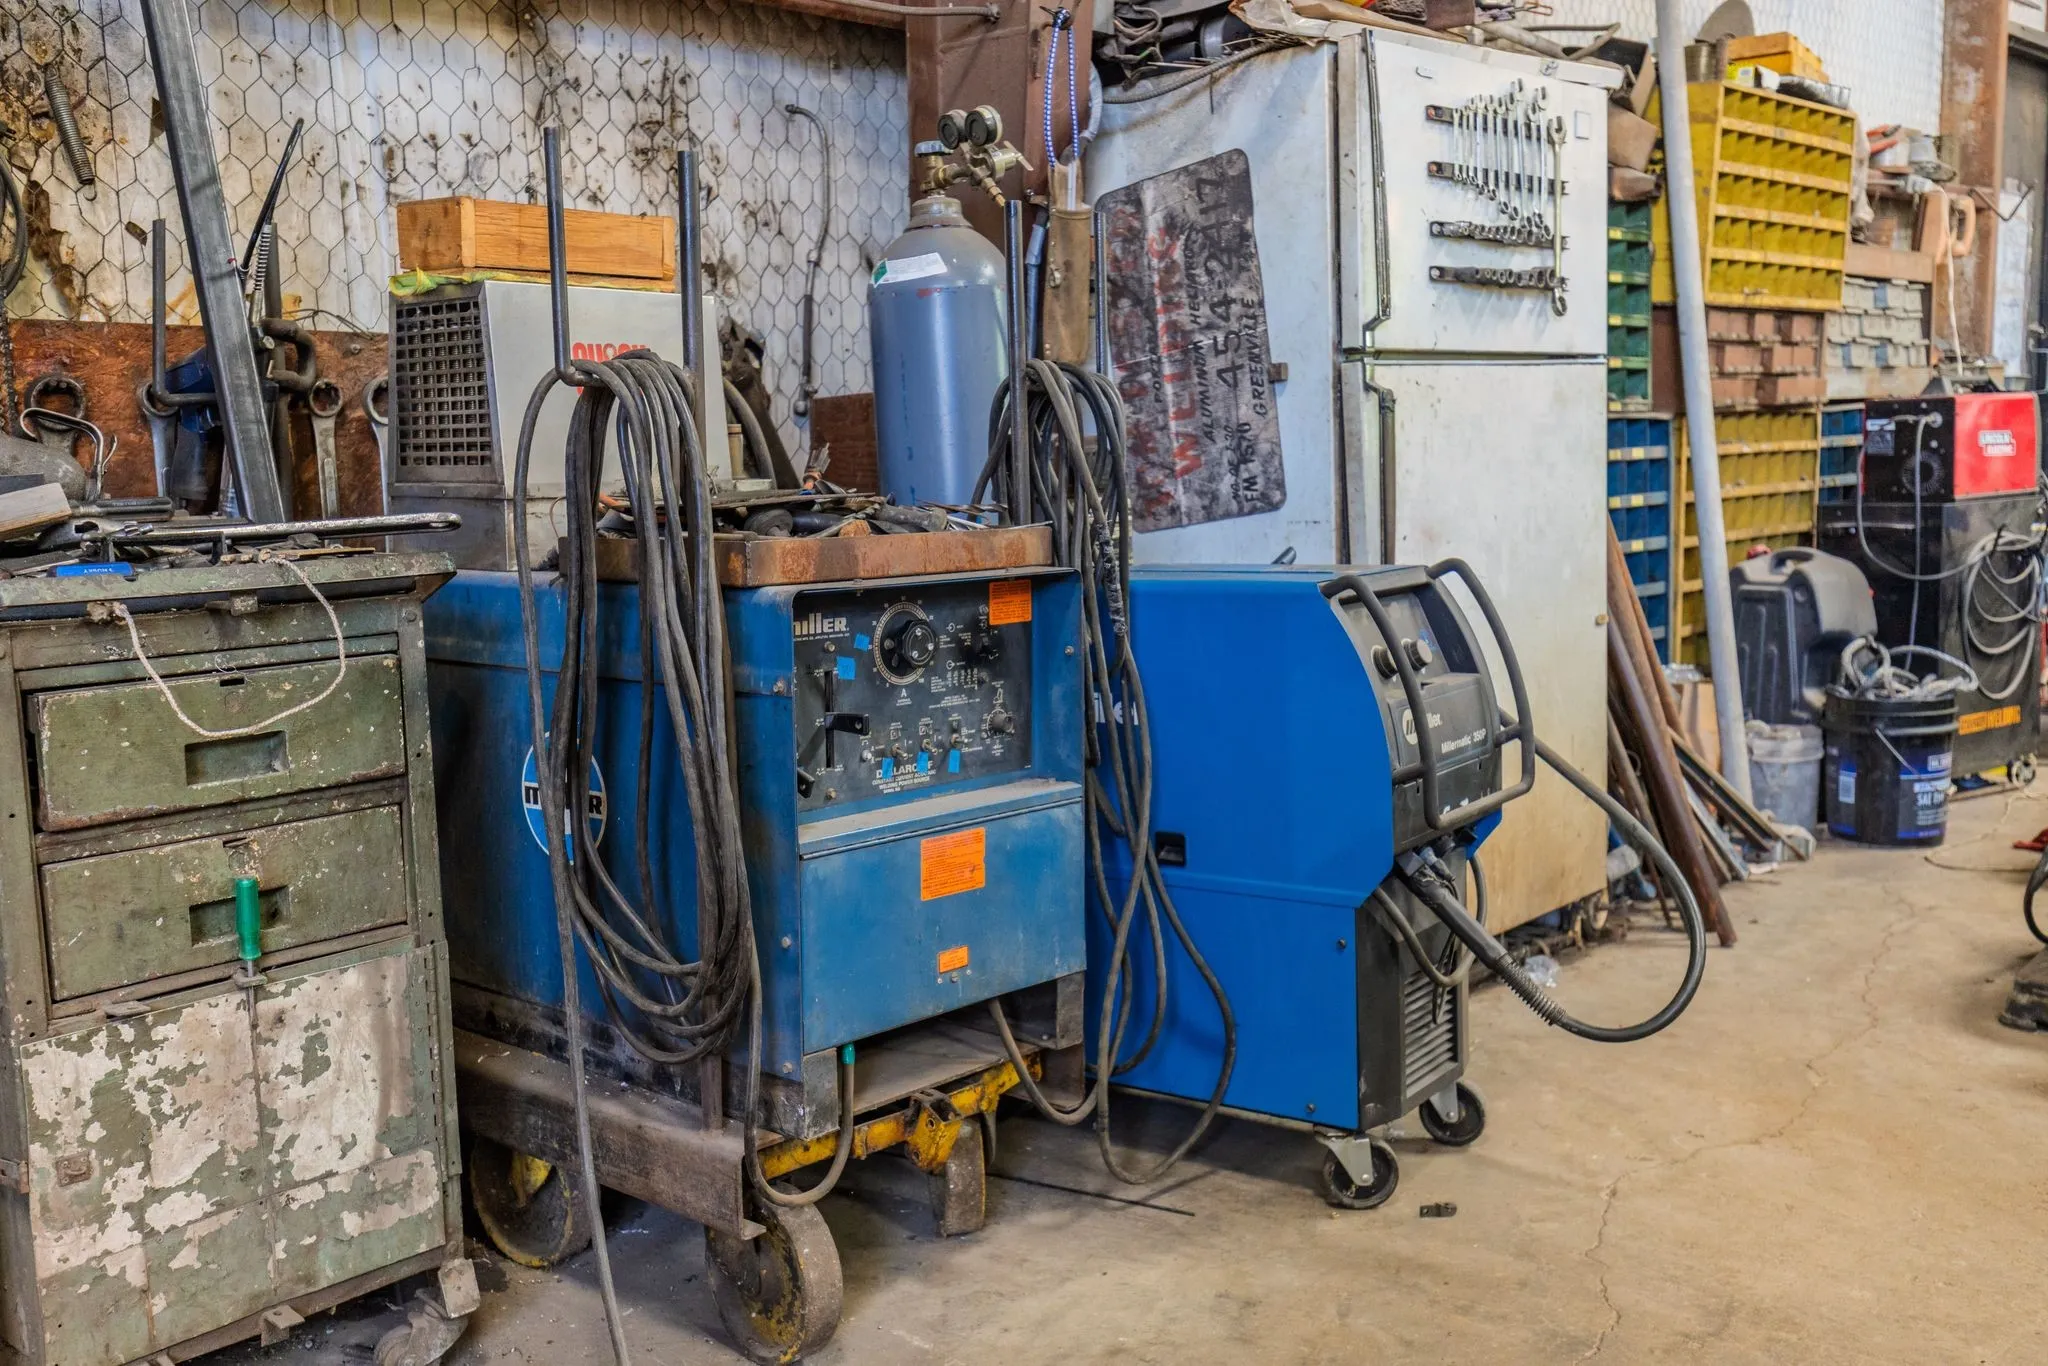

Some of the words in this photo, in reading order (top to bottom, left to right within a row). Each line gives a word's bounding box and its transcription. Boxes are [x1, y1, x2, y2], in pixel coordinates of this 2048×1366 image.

[1241, 297, 1267, 417] GREENVILLE
[1190, 340, 1216, 444] ALUMINUM
[1242, 475, 1259, 503] FM
[1441, 733, 1471, 754] Millermatic
[879, 781, 898, 790] WELDING
[899, 779, 913, 787] POWER
[914, 776, 930, 784] SOURCE
